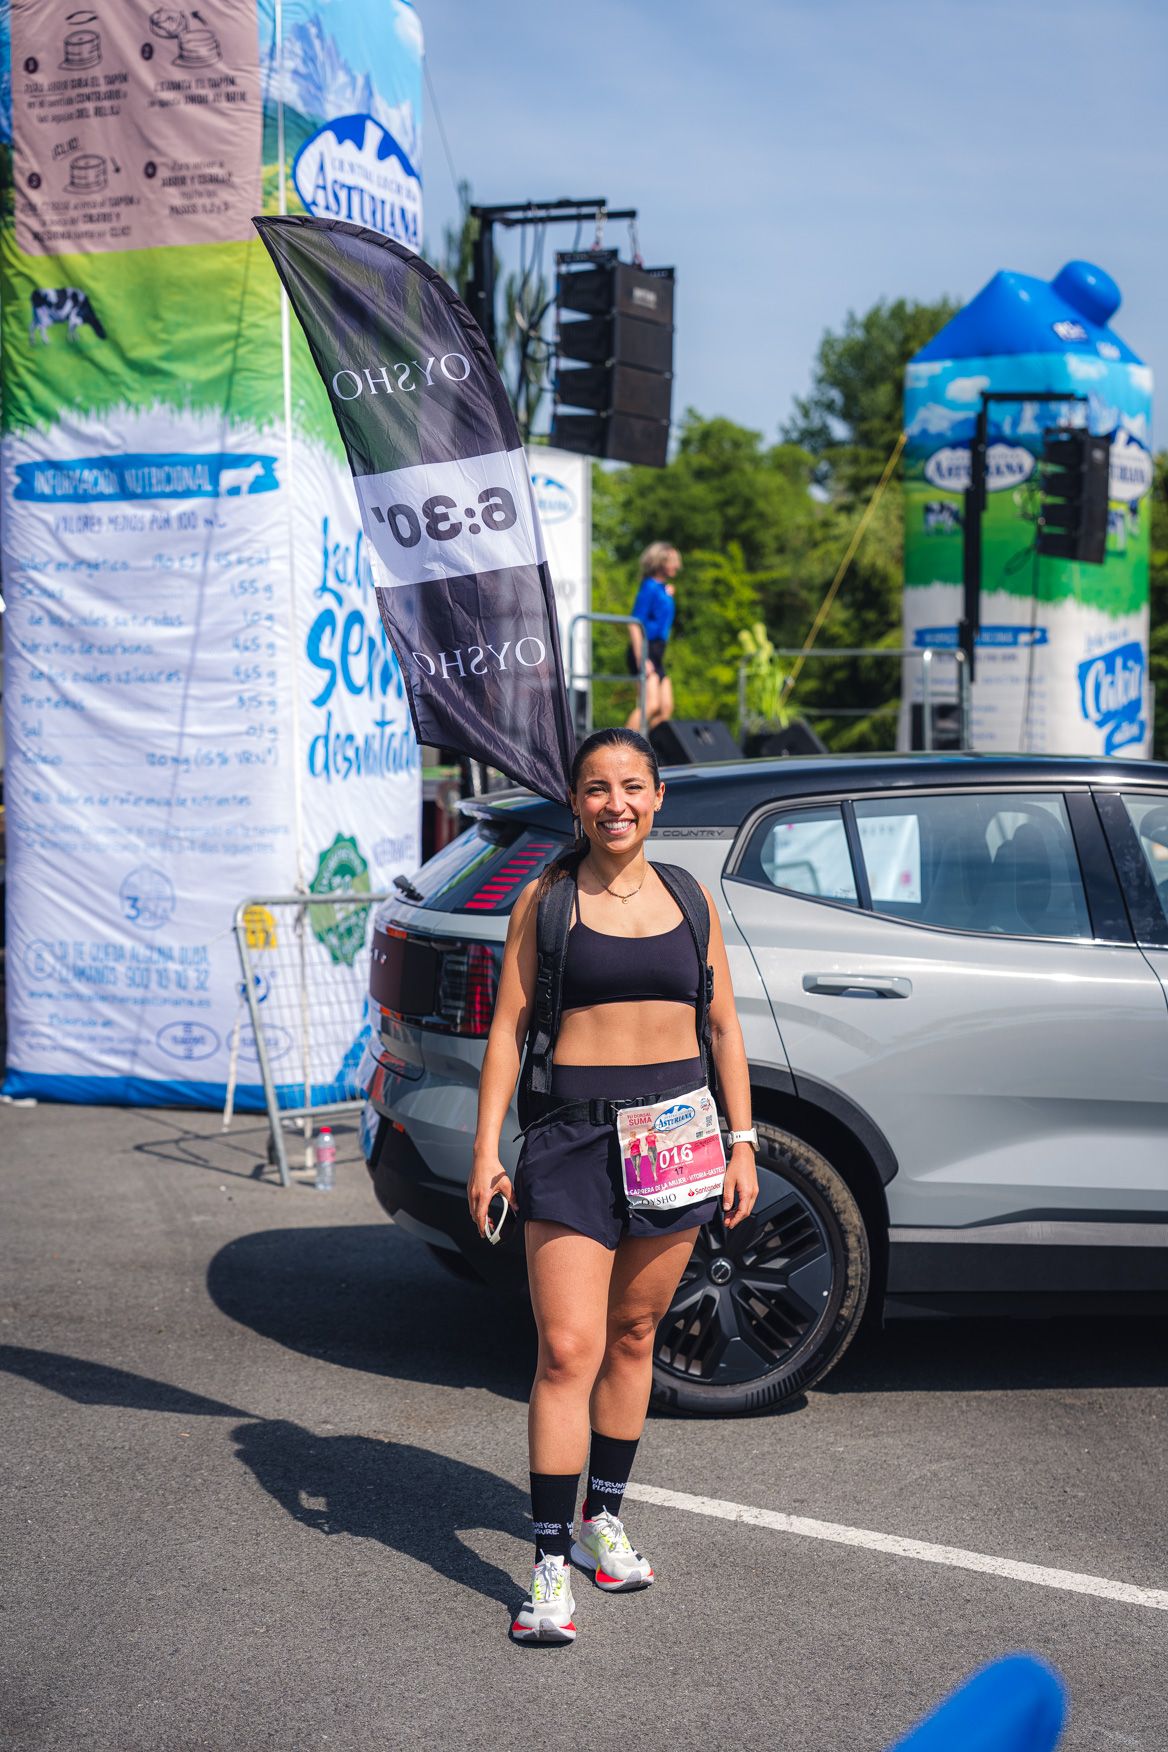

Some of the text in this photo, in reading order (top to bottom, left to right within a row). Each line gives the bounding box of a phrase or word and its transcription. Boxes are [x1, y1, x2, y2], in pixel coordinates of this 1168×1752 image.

[662, 829, 725, 838] COUNTRY
[628, 1116, 653, 1127] SUMA
[659, 1143, 694, 1169] 016
[695, 1182, 722, 1196] Santander
[641, 1192, 677, 1207] OYSHO
